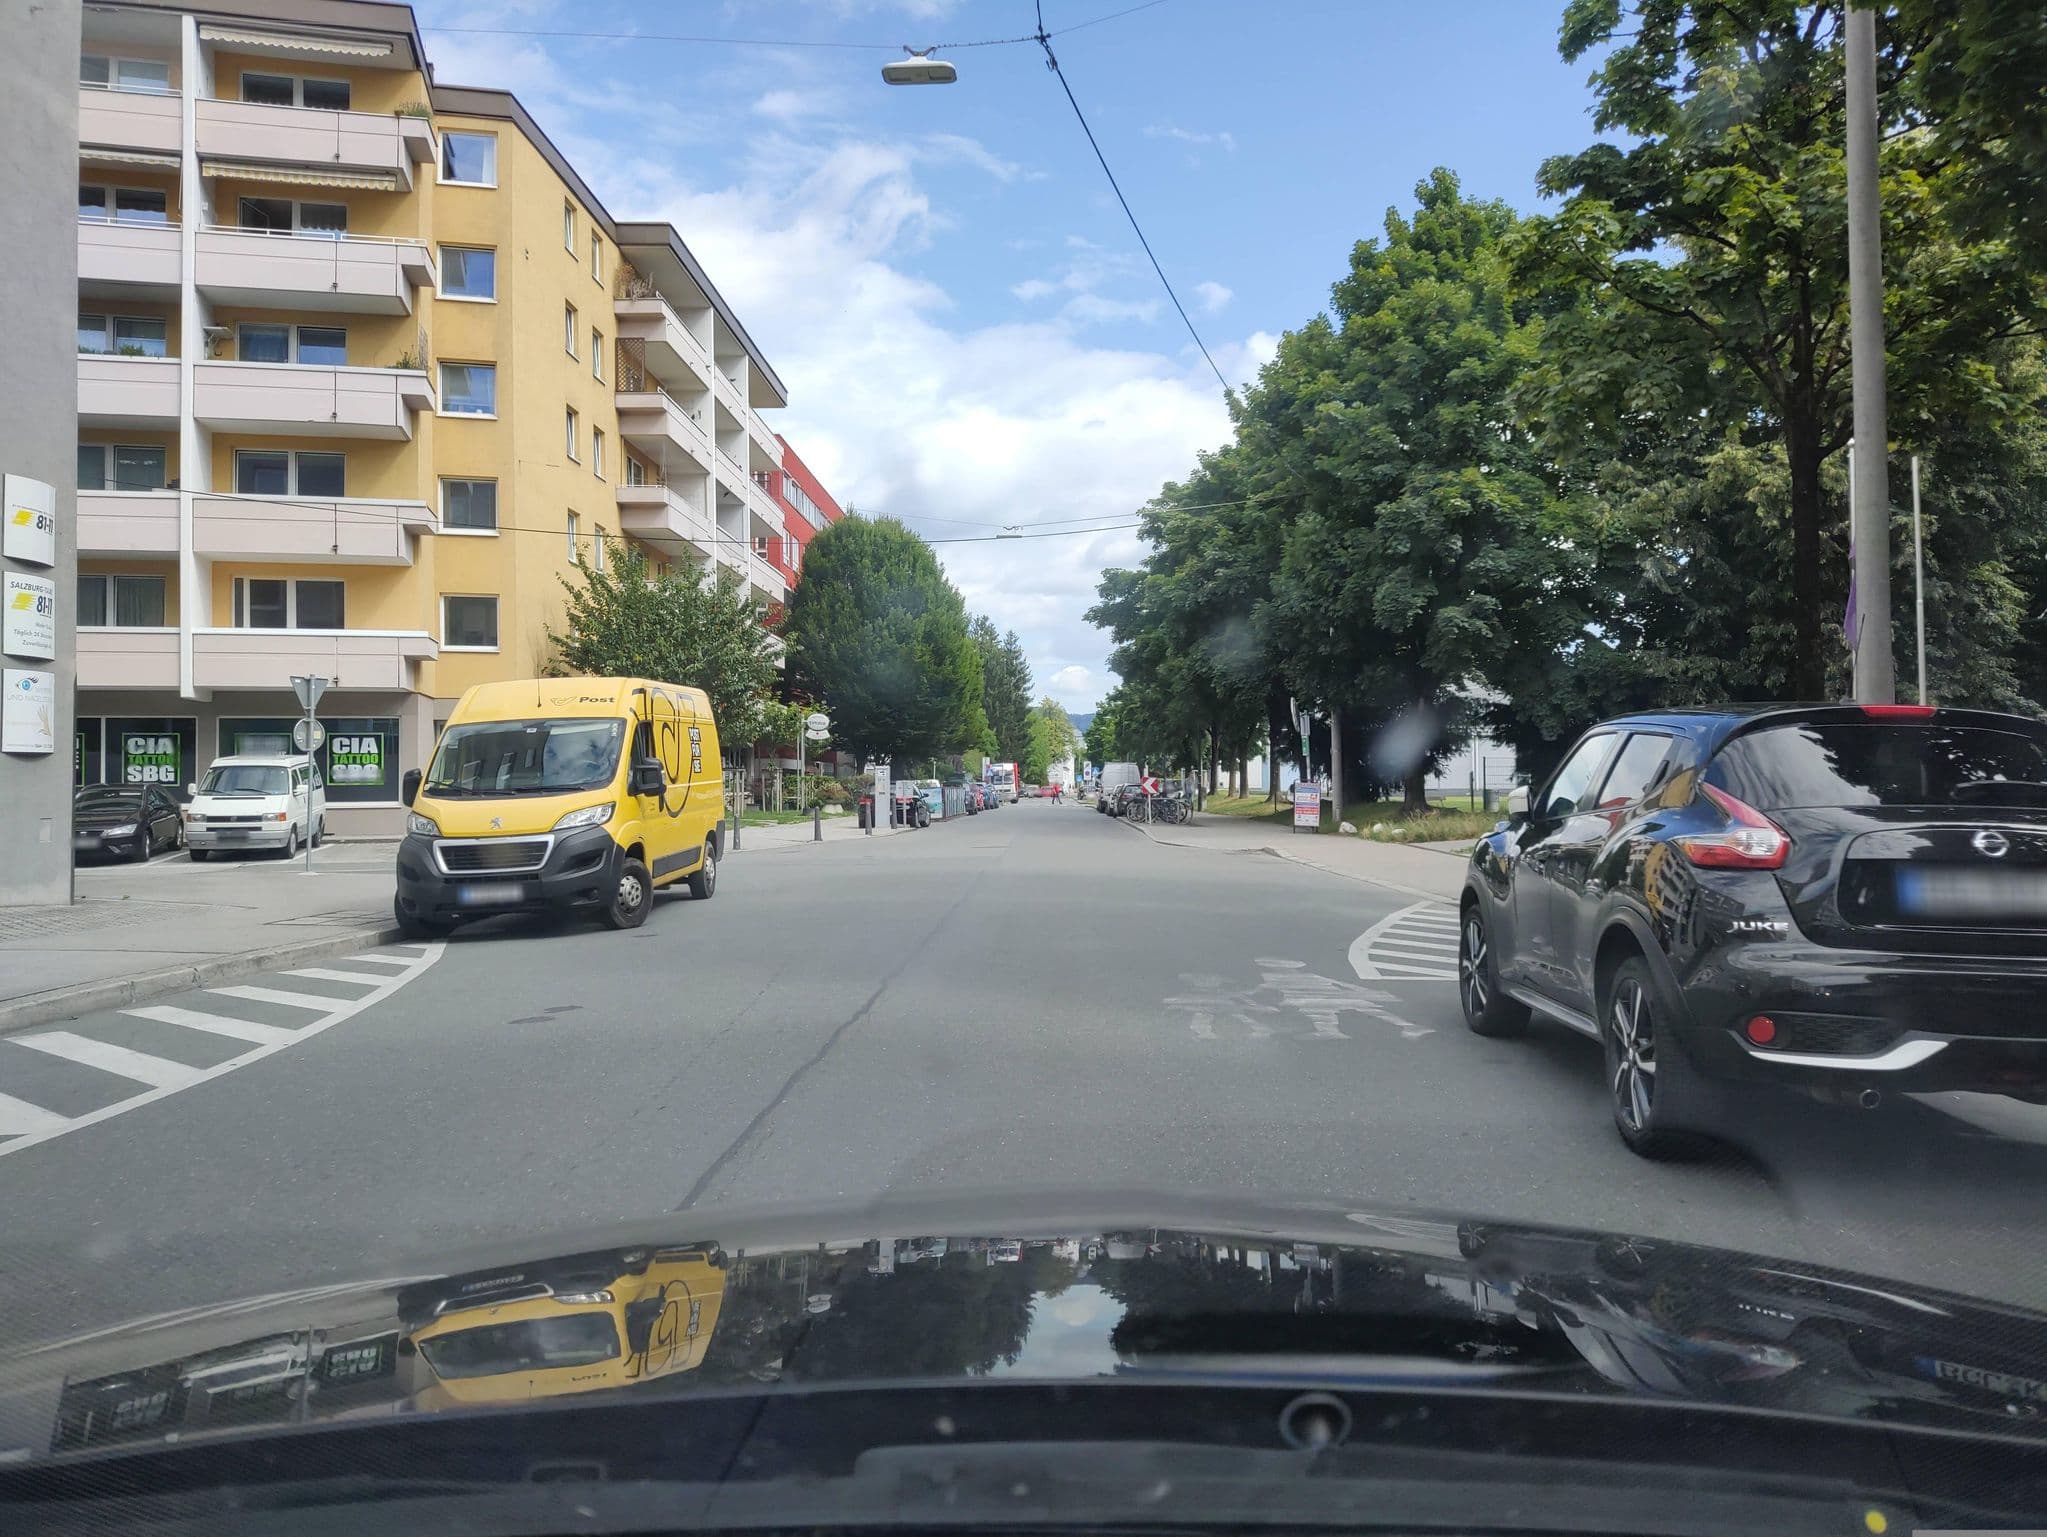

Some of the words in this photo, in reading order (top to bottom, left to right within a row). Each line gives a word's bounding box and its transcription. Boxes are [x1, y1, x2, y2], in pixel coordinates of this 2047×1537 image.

[127, 738, 174, 754] CIA
[332, 737, 378, 753] CIA
[332, 753, 379, 764] TATTOO
[127, 765, 175, 781] SBG
[1726, 921, 1789, 933] JUKE
